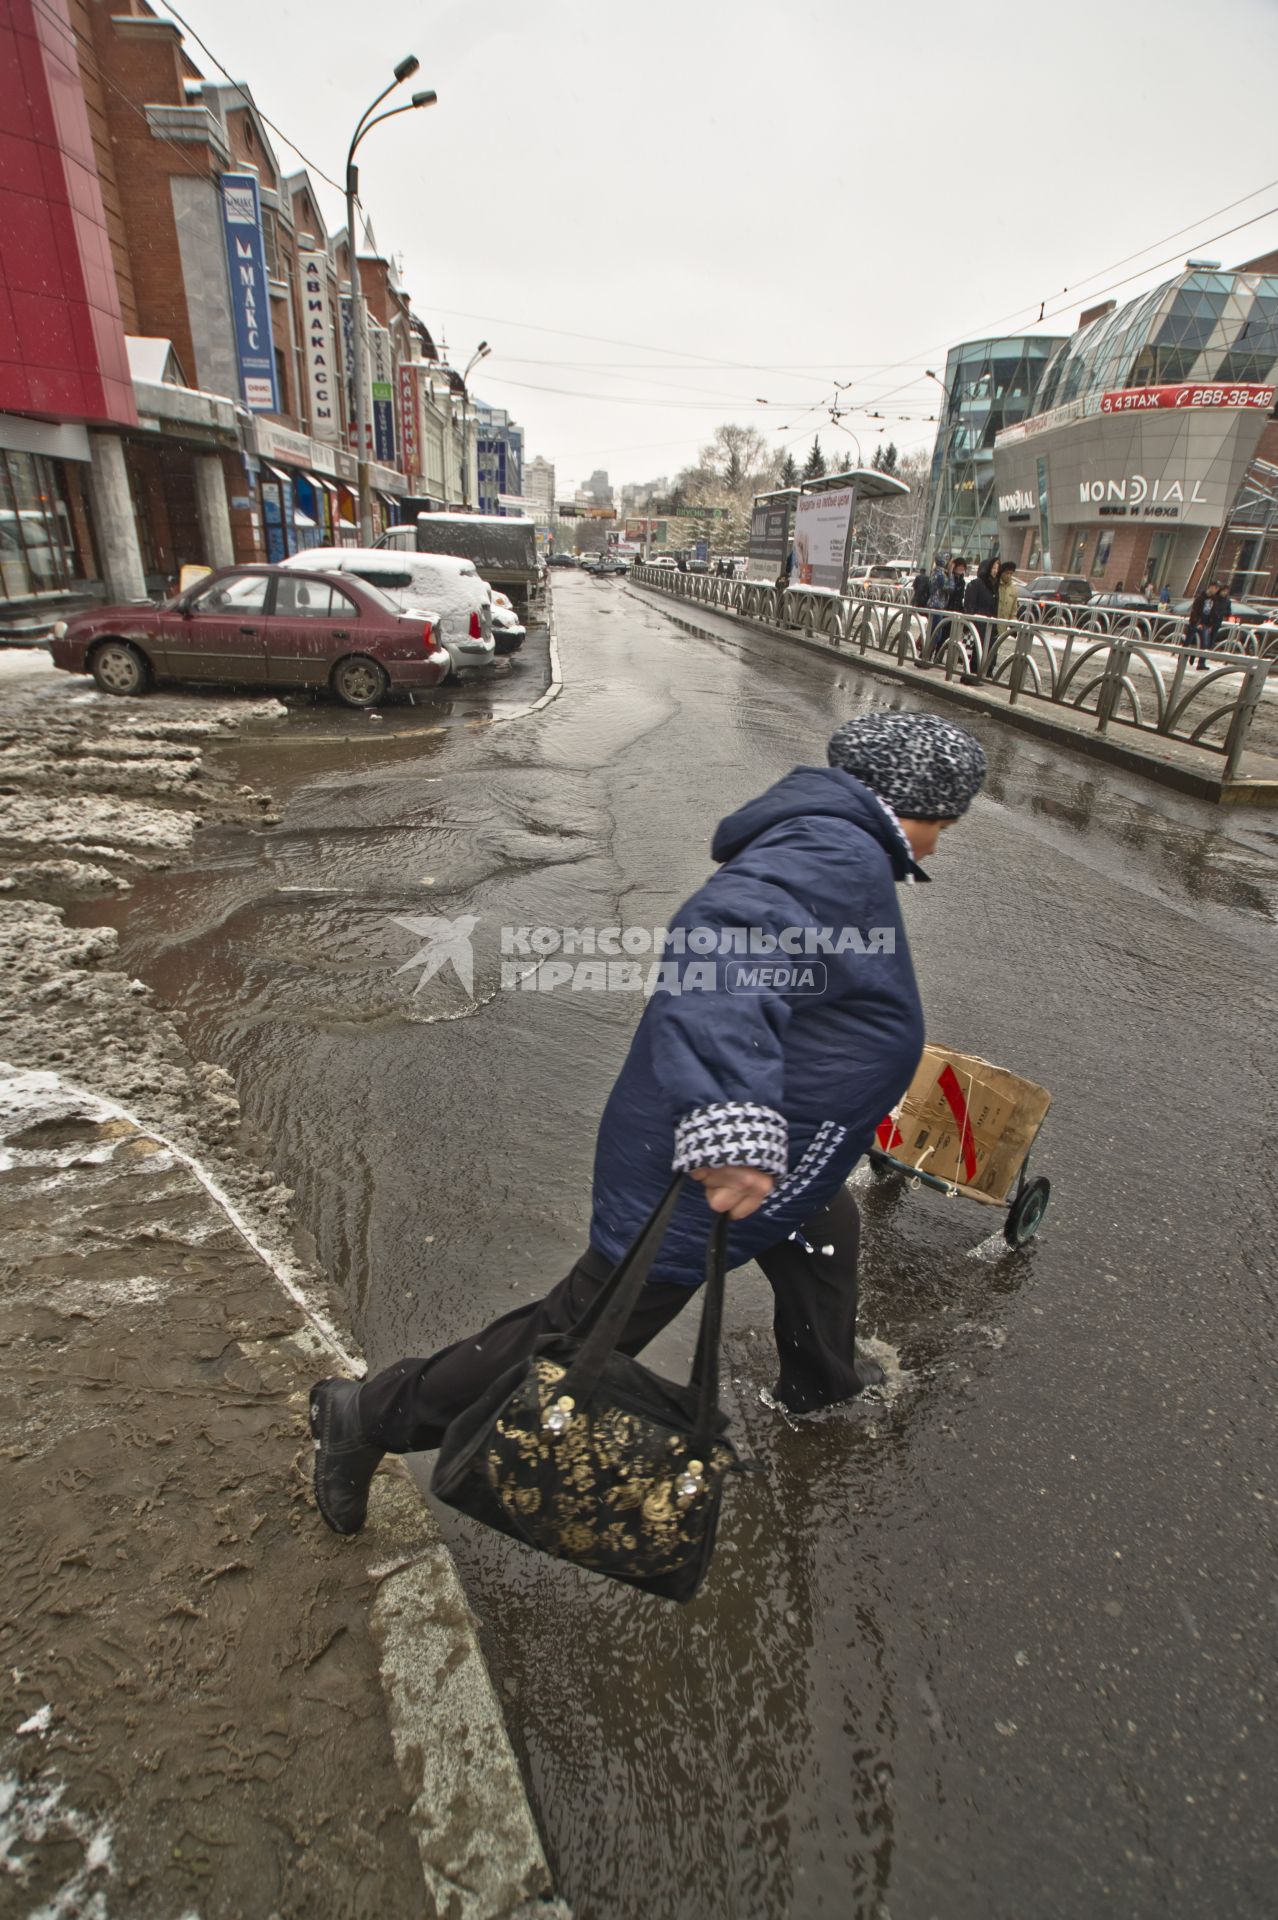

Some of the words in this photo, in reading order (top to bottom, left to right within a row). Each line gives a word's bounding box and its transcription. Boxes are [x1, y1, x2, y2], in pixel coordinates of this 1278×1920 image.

[239, 266, 260, 350] МАКС
[306, 262, 331, 418] АВИАКАССЫ
[402, 371, 417, 454] КАМИНЫ
[1124, 394, 1159, 408] ЭТАЖ
[1191, 389, 1273, 406] 268-38-48
[999, 490, 1036, 513] MONDIAL
[1080, 475, 1207, 506] MONDIAL
[1143, 507, 1178, 517] меха
